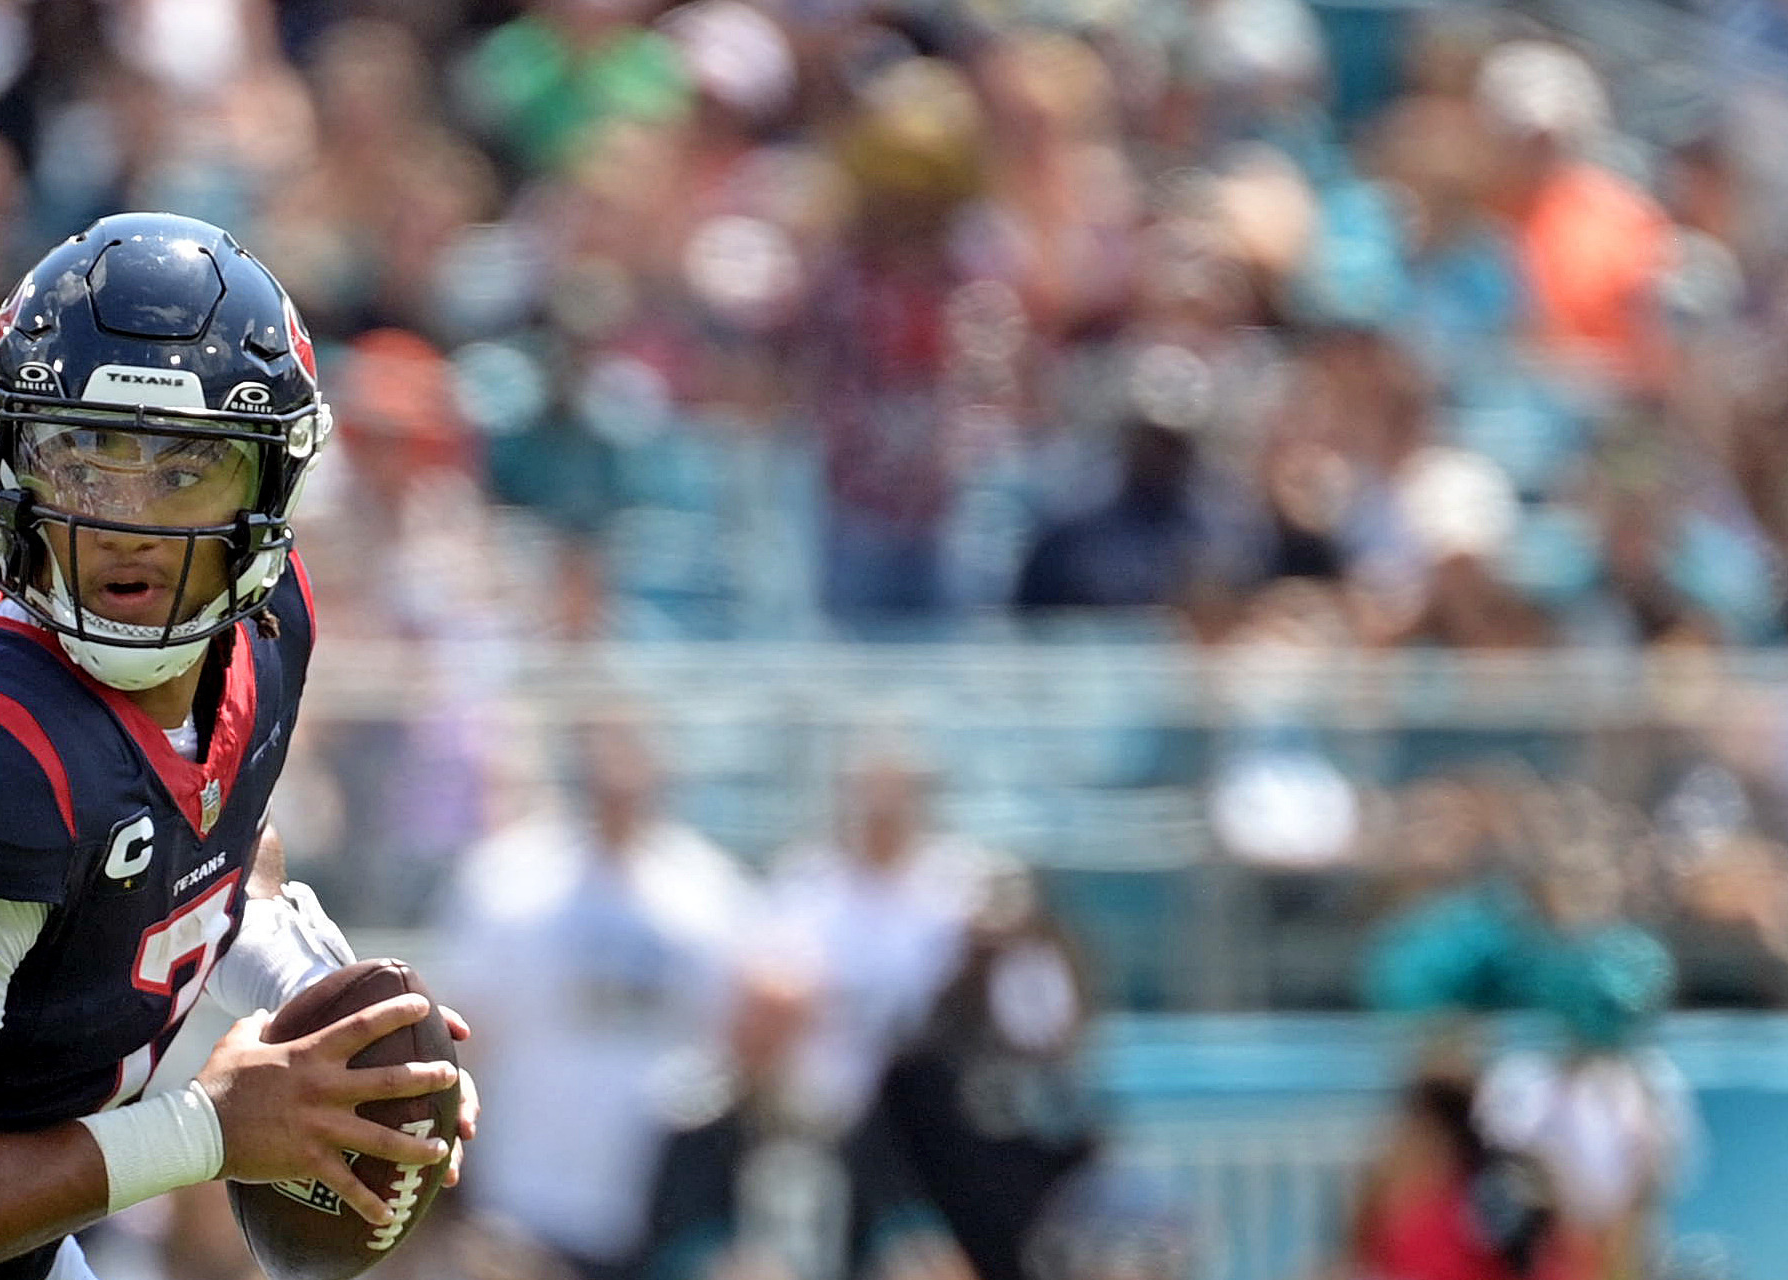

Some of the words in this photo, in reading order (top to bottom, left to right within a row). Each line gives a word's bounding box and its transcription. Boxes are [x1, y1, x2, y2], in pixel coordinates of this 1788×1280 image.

[15, 380, 56, 391] OAKLEY
[106, 372, 184, 387] TEXANS
[230, 401, 272, 413] OAKLEY
[104, 816, 155, 879] C
[173, 851, 227, 897] TEXANS
[96, 867, 243, 1113] 7
